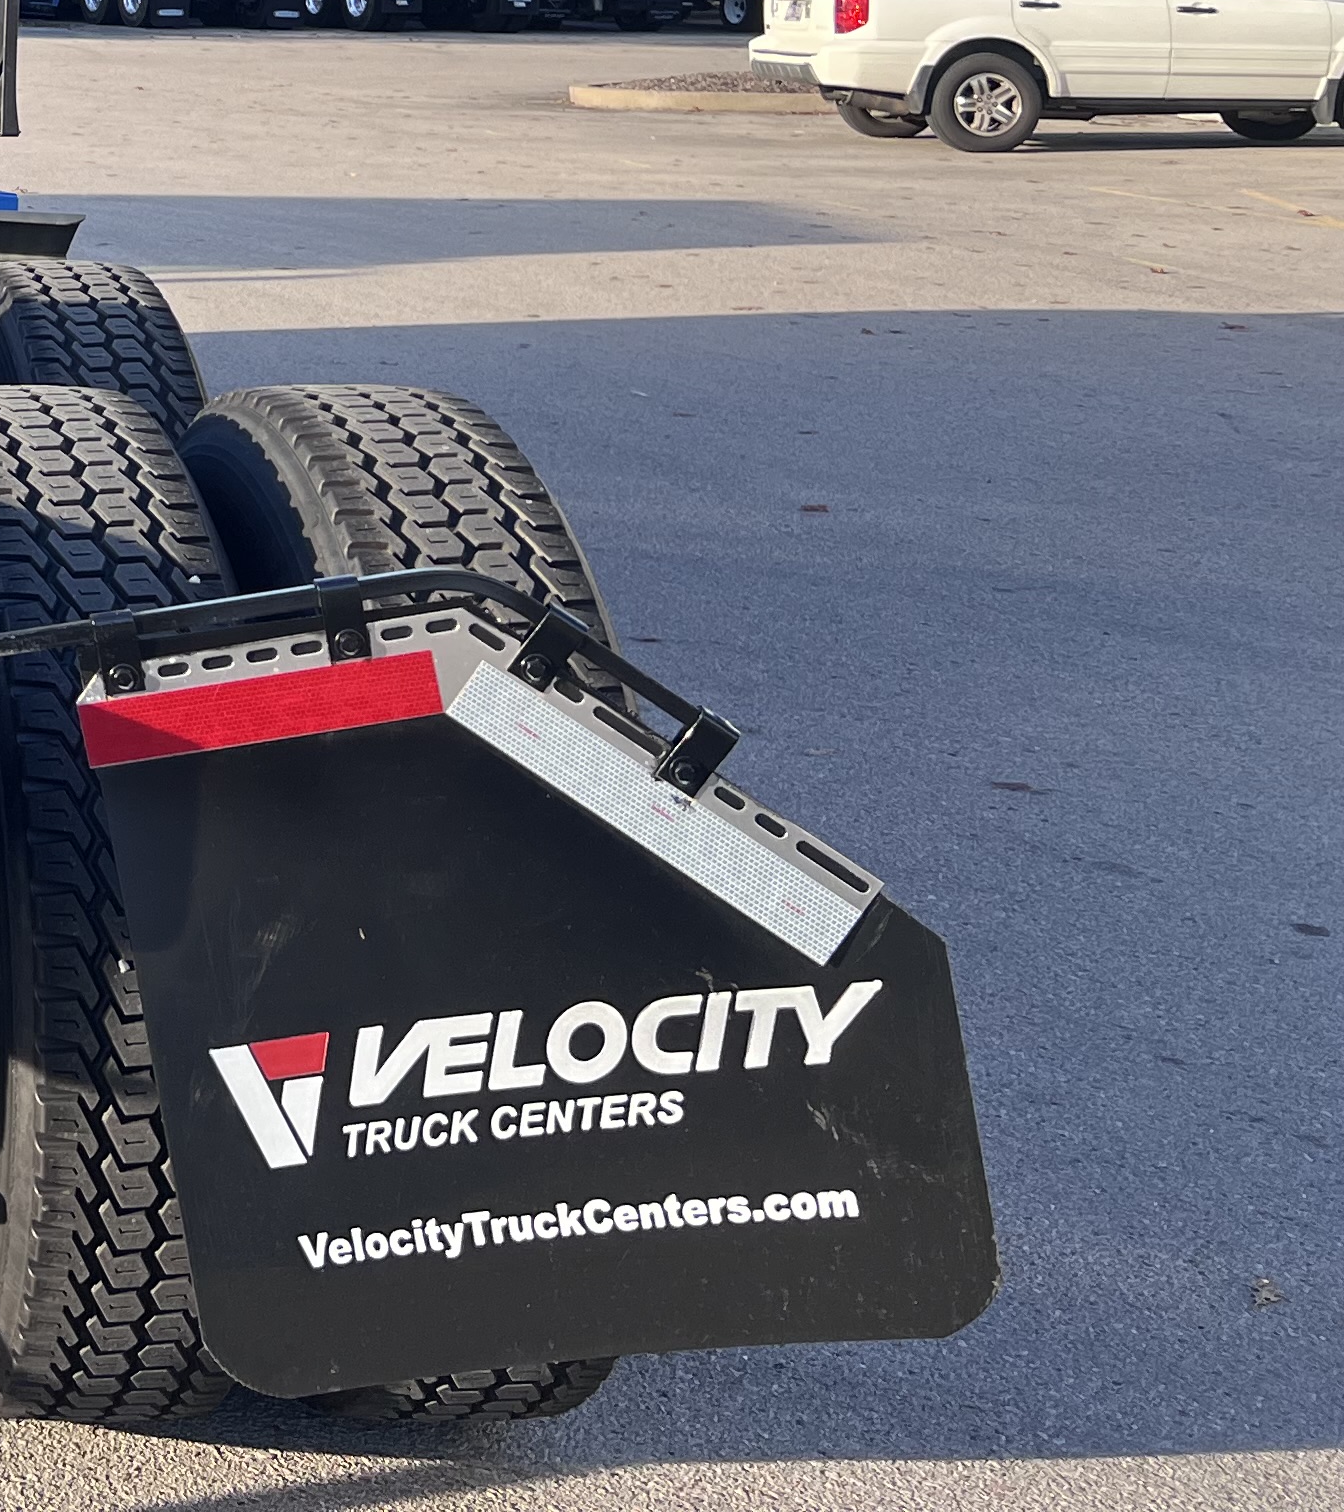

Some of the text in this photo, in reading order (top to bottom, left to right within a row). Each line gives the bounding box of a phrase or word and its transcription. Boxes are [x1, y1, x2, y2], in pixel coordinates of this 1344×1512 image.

[347, 979, 883, 1108] VELOCITY
[341, 1090, 686, 1159] TRUCK CENTERS
[297, 1184, 860, 1270] VelocityTruckCenters.com
